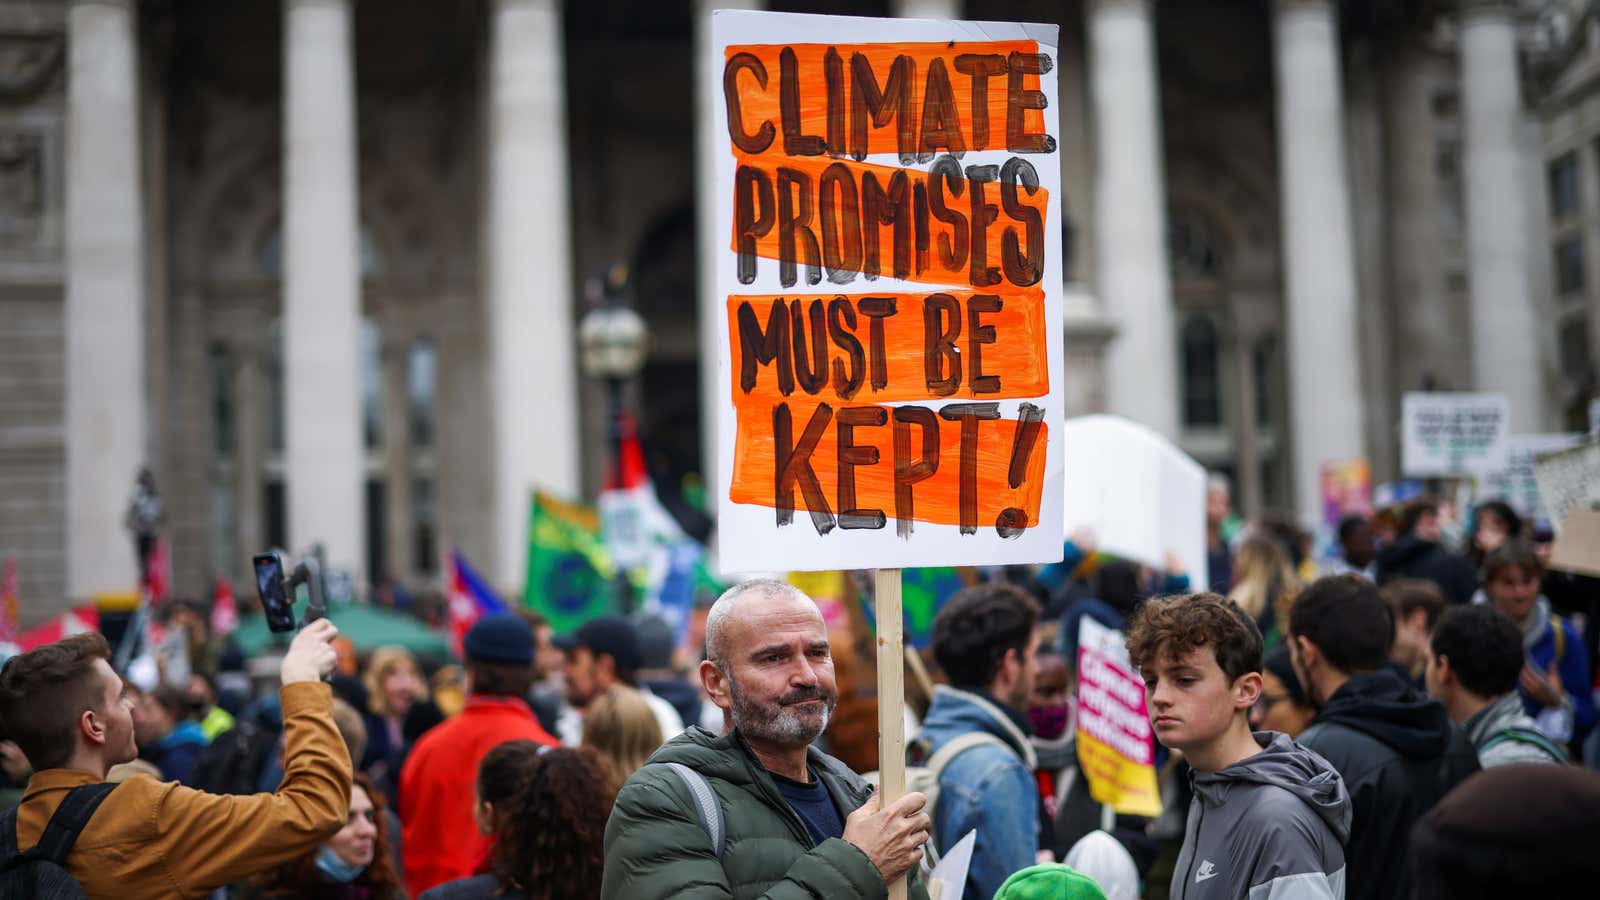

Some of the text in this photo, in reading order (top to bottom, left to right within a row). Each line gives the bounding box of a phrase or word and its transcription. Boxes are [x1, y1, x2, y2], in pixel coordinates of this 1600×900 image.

[724, 46, 1056, 165] CLIMATE
[737, 154, 1044, 288] PROMISES
[738, 293, 1003, 400] MUST BE
[773, 402, 1046, 540] KEPT!
